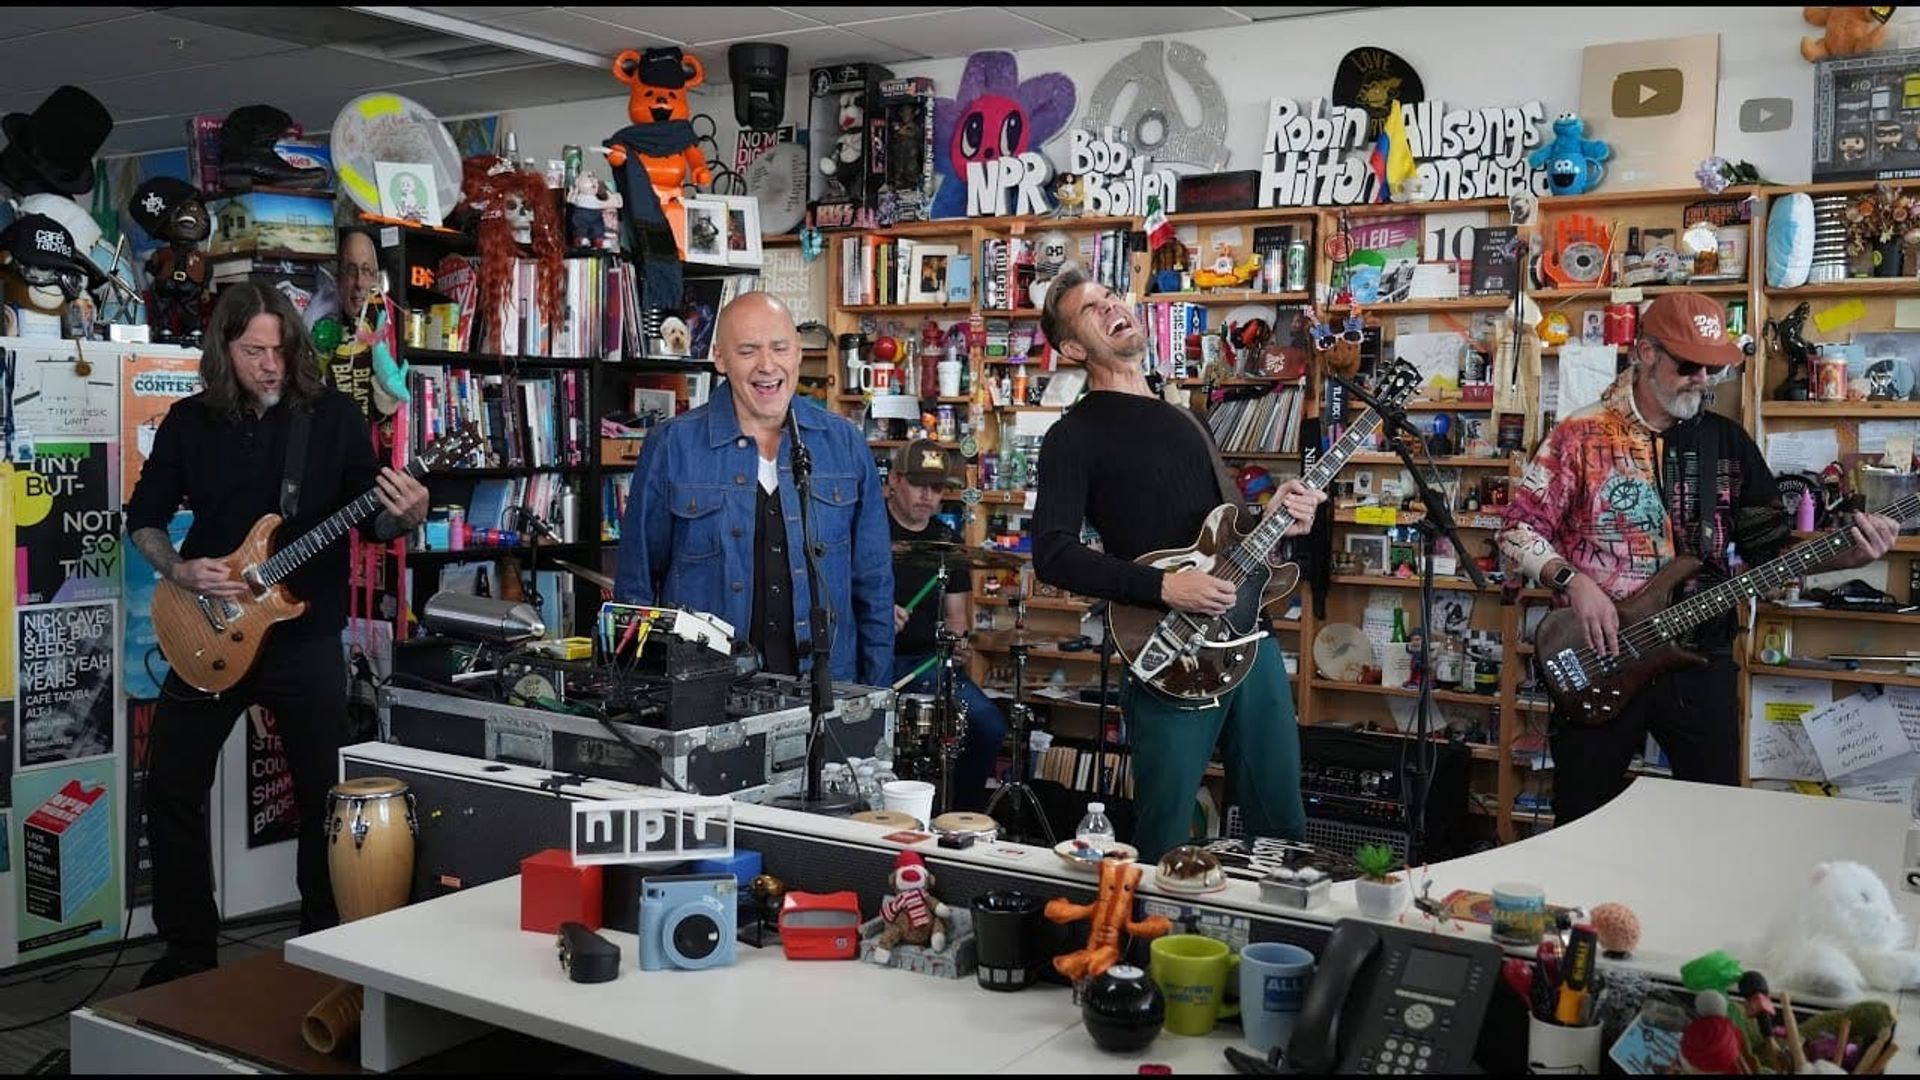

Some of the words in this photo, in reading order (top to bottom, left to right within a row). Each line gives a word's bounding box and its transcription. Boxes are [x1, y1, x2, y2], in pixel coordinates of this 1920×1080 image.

[1350, 50, 1392, 73] LOVE
[1264, 96, 1368, 153] Robin
[739, 131, 761, 148] NO
[1071, 127, 1128, 175] Bob
[967, 152, 1049, 217] NPR
[1084, 155, 1177, 217] Boilen
[1258, 148, 1382, 208] Hilton
[1428, 225, 1477, 262] 10
[30, 452, 83, 474] TINY
[26, 475, 85, 497] BUT-
[62, 510, 117, 533] NOT
[82, 533, 116, 554] SO
[59, 556, 116, 580] TINY
[24, 612, 63, 630] NICK
[66, 609, 107, 626] CAVE
[70, 623, 104, 641] BAD
[24, 640, 77, 660] SEEDS
[24, 659, 67, 679] YEAH
[69, 653, 111, 673] YEAH
[24, 672, 78, 692] YEAHS
[585, 807, 712, 852] npr
